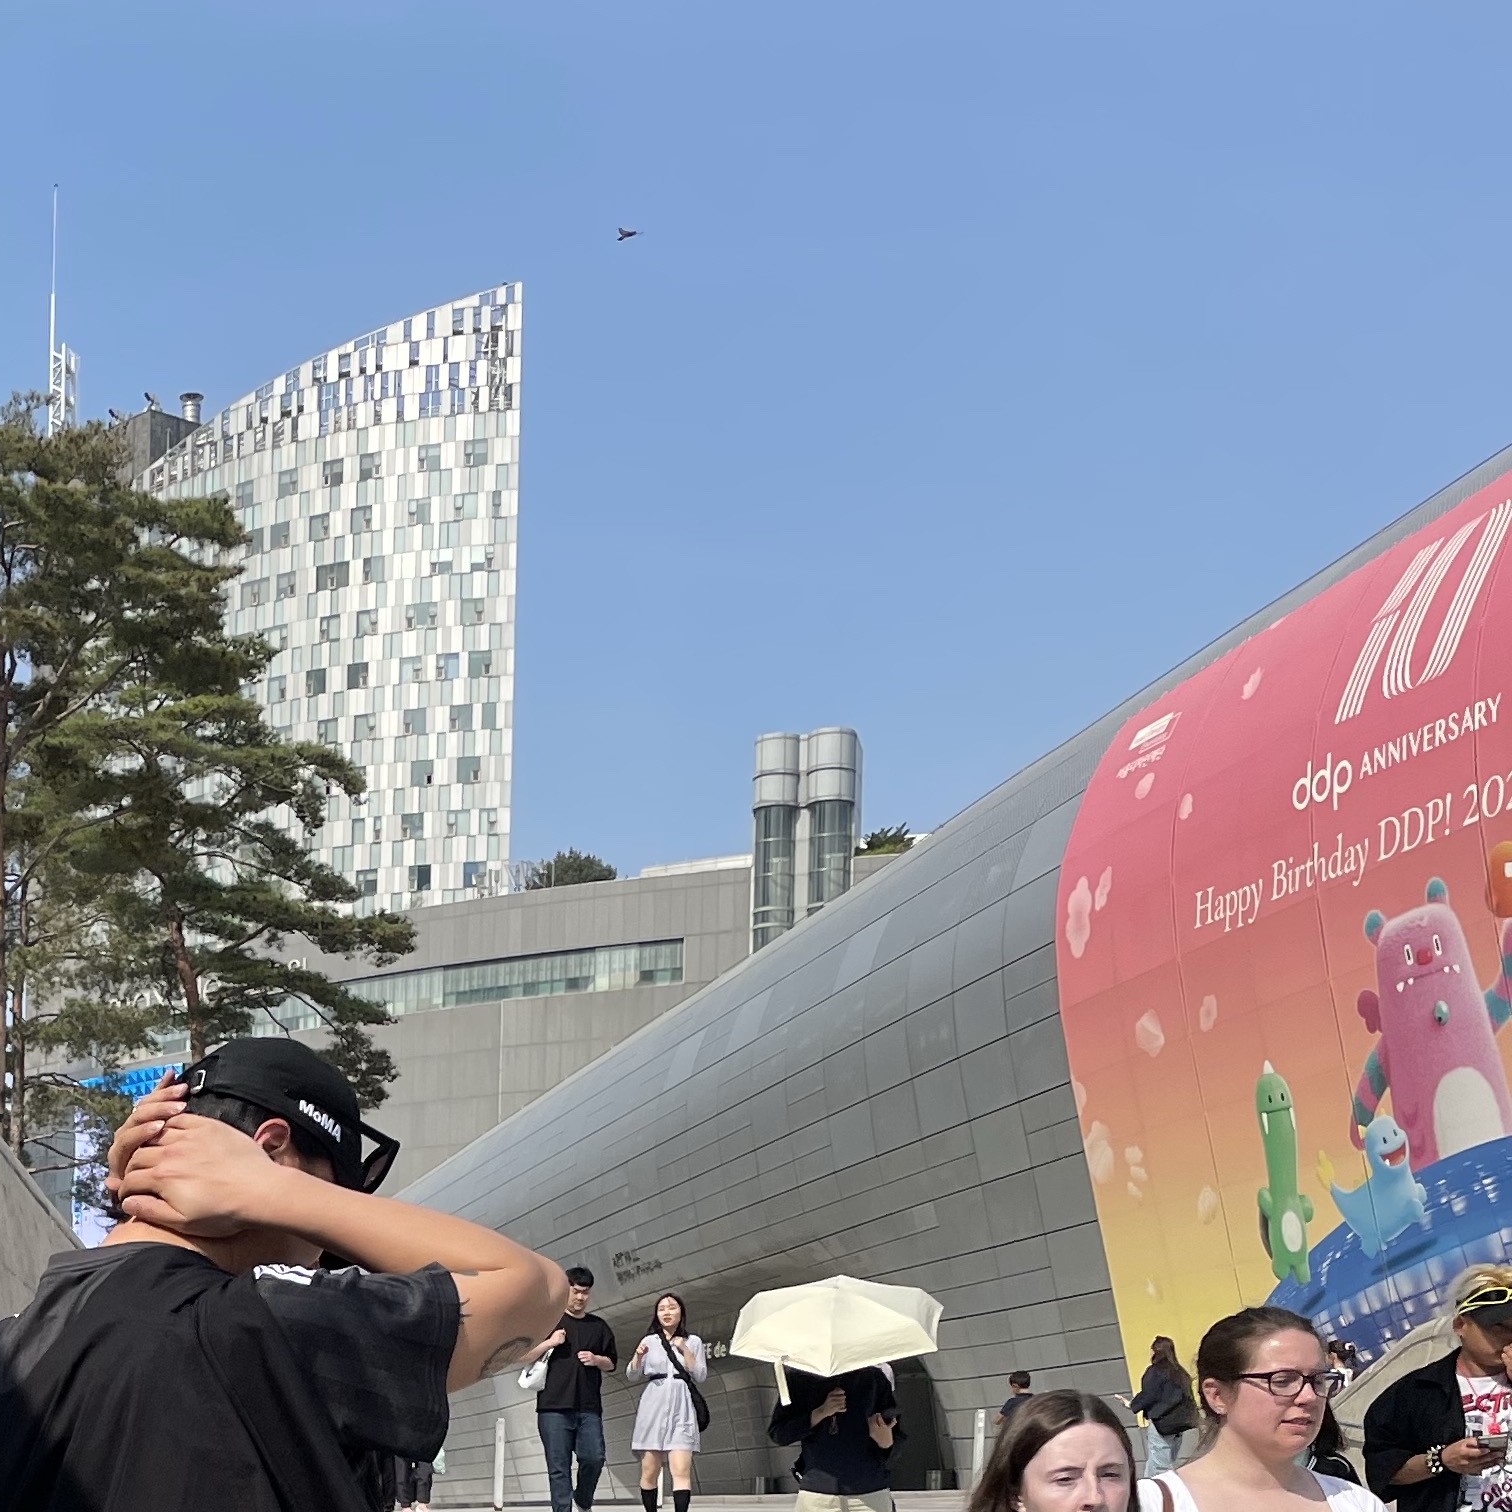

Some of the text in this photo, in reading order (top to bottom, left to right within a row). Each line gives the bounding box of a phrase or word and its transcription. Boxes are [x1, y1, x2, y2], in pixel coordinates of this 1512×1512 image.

[1334, 498, 1512, 724] 10
[1292, 692, 1502, 811] ddp ANNIVERSARY
[1194, 879, 1263, 932] Happy
[1271, 833, 1369, 901] Birthday
[1377, 793, 1452, 861] DDP!
[299, 1099, 341, 1143] MoMA
